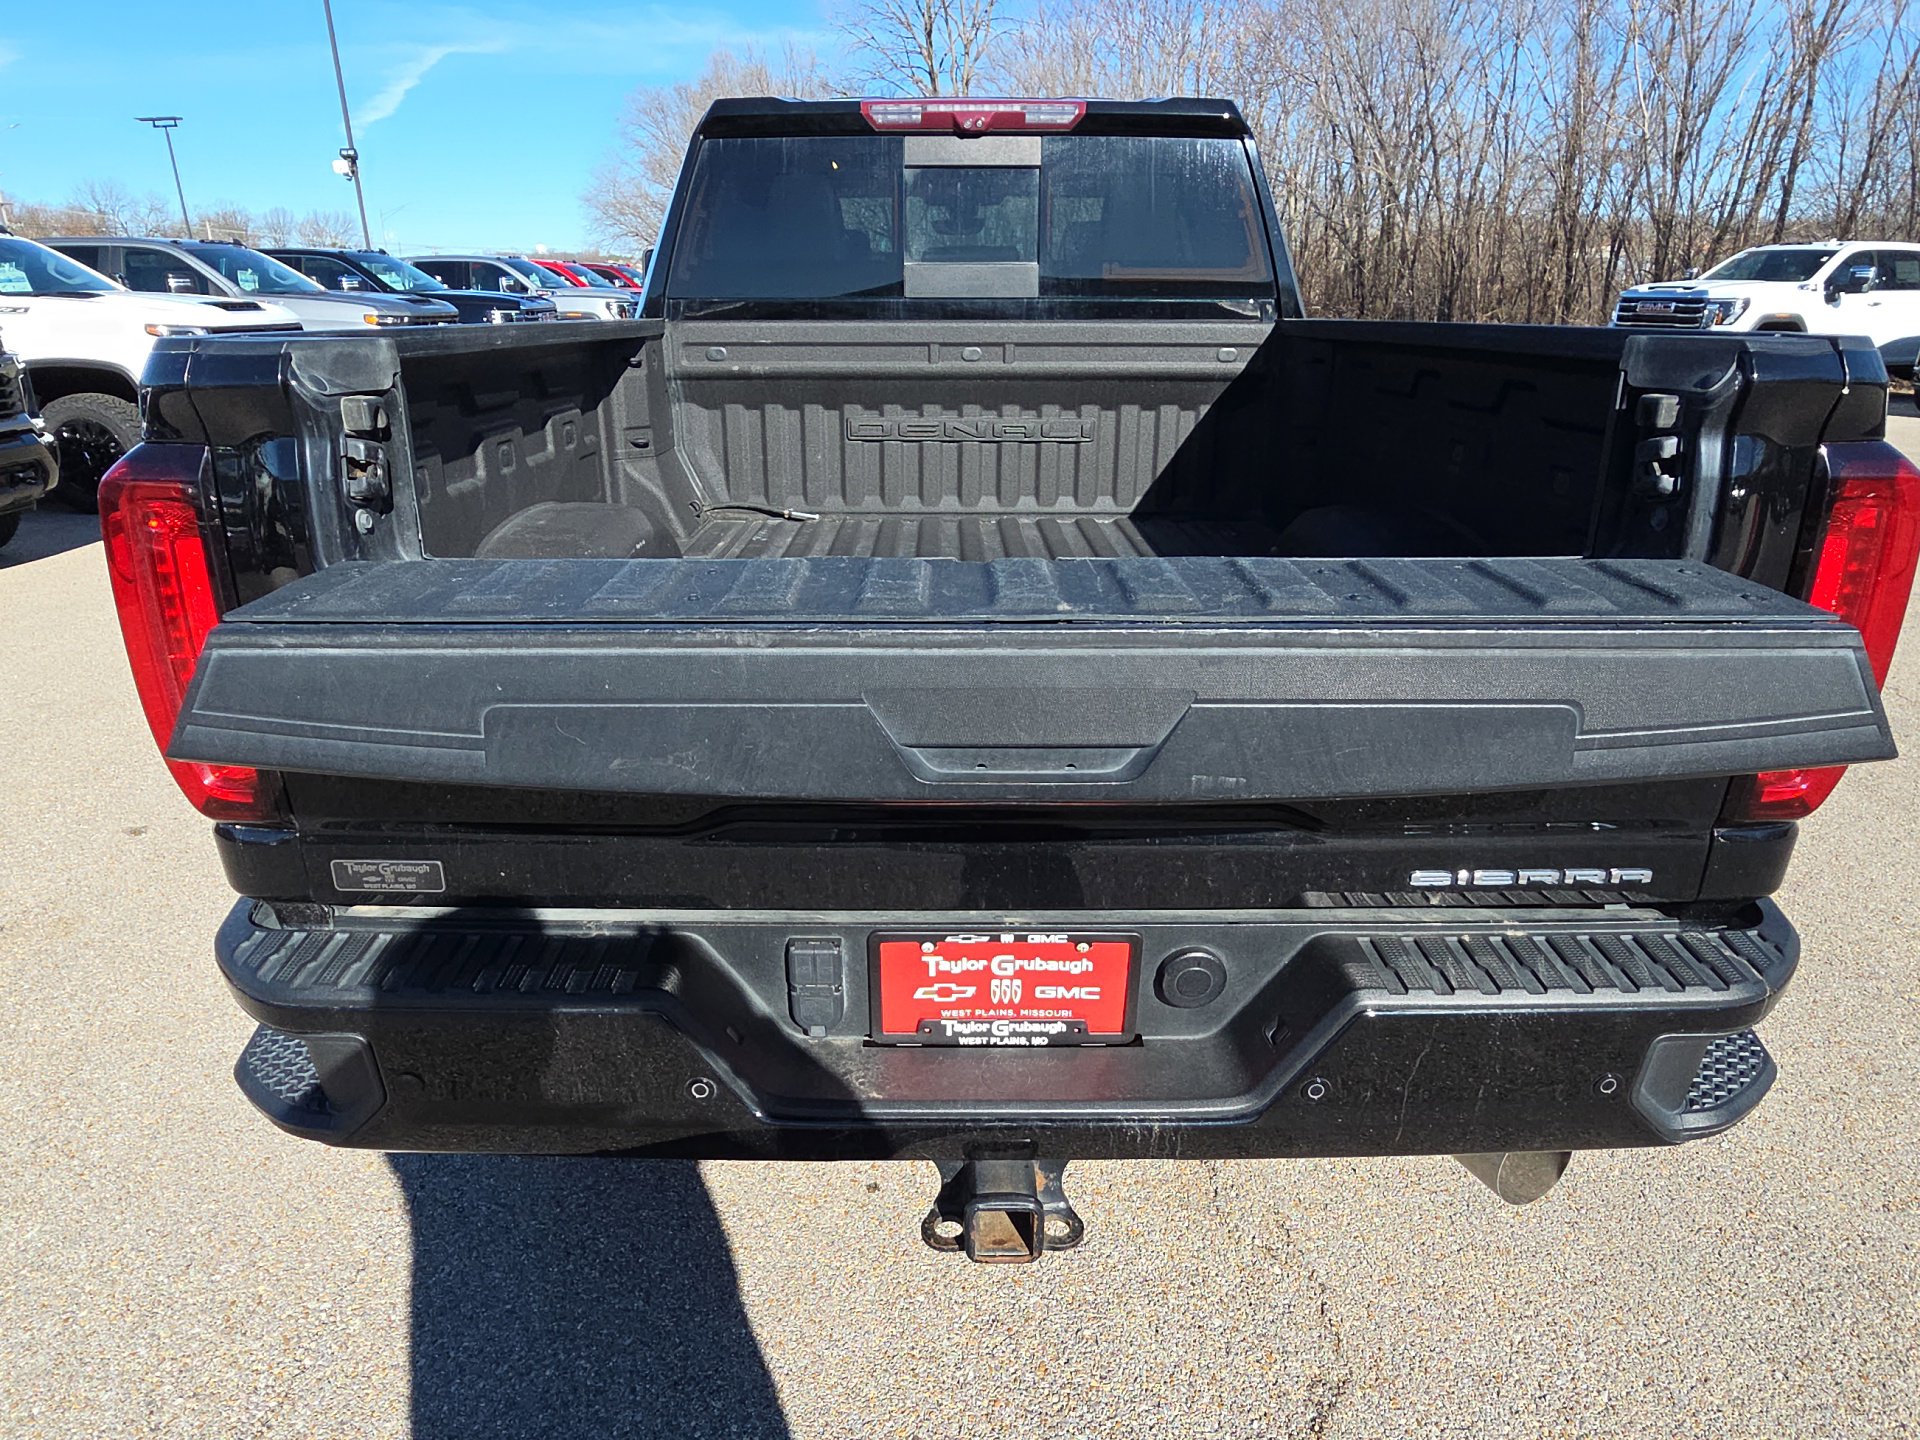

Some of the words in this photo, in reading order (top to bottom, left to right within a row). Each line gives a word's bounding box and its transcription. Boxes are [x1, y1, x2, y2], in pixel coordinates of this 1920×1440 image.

[849, 420, 1093, 439] DENALI
[343, 862, 377, 876] Taylor
[379, 863, 430, 875] Grubaugh
[1409, 868, 1653, 886] SIERRA
[1027, 934, 1068, 943] GMC
[921, 955, 988, 977] Taylor
[990, 954, 1093, 976] Grubaugh
[1034, 986, 1101, 999] GMC
[940, 1009, 972, 1017] WEST
[975, 1009, 1016, 1017] PLAINS,
[1020, 1009, 1072, 1017] MISSOURI
[940, 1019, 990, 1036] Taylor
[991, 1019, 1067, 1036] Grubaugh
[958, 1036, 989, 1045] WEST
[989, 1036, 1029, 1046] PLAINS,
[1031, 1036, 1048, 1046] MO
